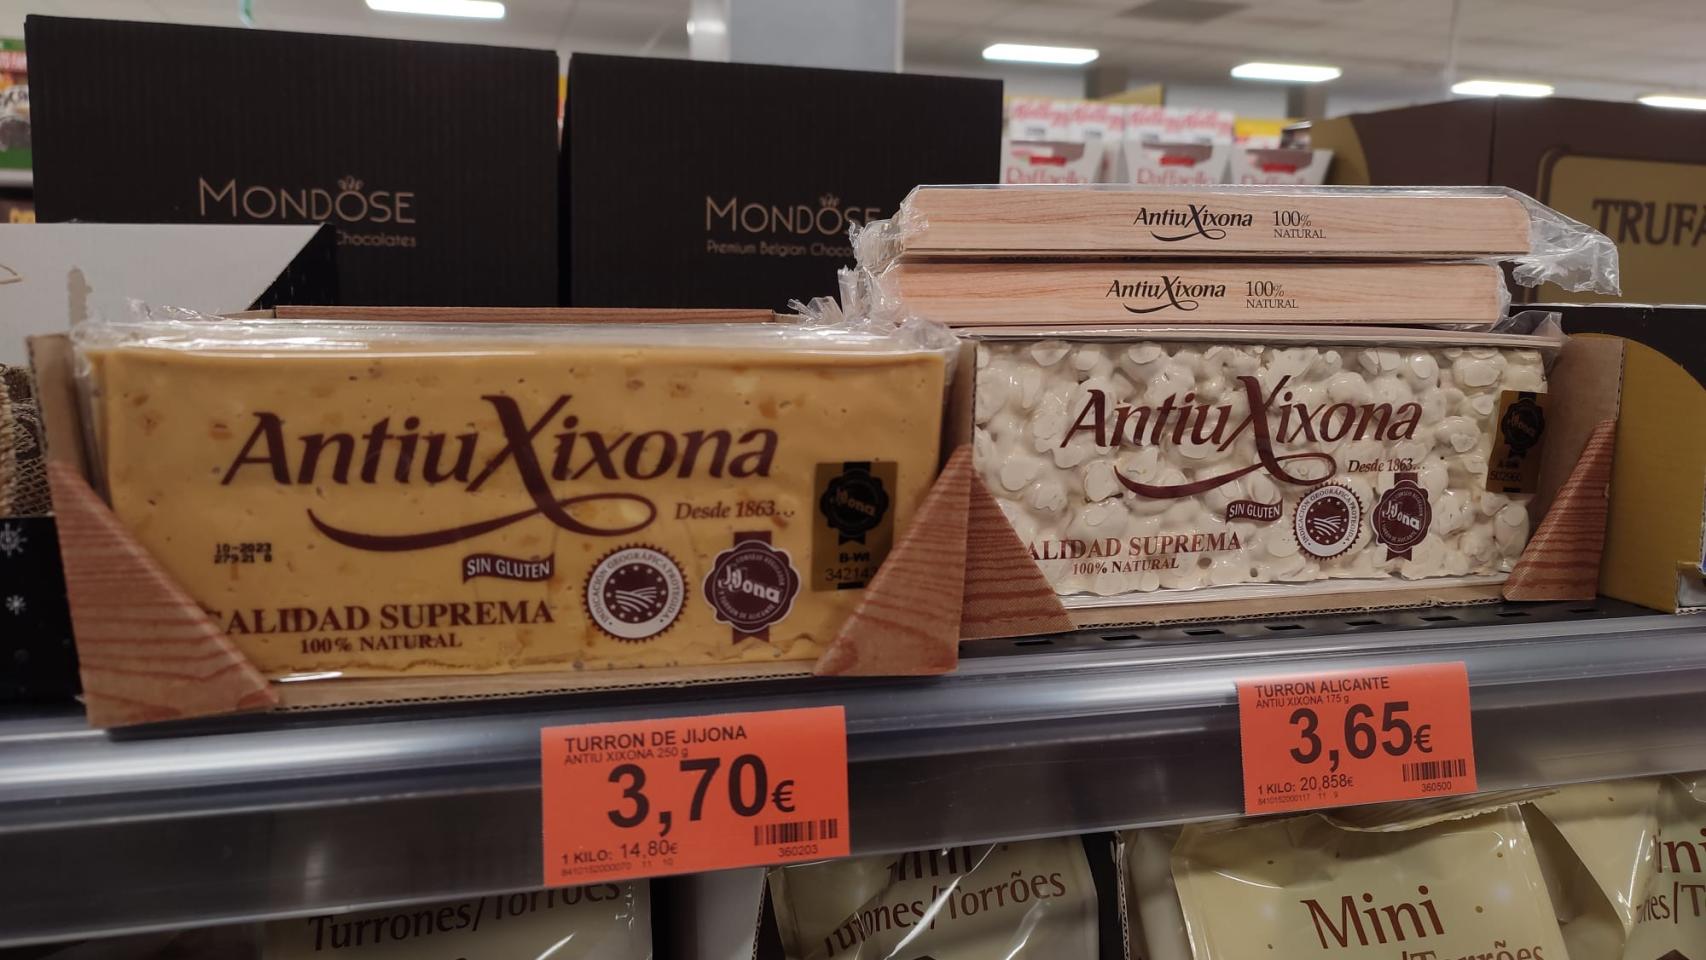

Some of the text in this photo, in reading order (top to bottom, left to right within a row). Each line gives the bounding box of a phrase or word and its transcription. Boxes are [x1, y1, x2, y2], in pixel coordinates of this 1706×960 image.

[1133, 204, 1253, 241] AntiuXixona
[1272, 210, 1312, 227] 100%
[1273, 228, 1327, 239] NATURAL
[707, 240, 757, 255] Premium
[760, 241, 807, 257] Belgian
[1107, 275, 1226, 313] AntiuXixona
[1245, 280, 1285, 297] 100%
[1246, 298, 1299, 309] NATURAL
[1061, 375, 1423, 498] AntiuXixona
[221, 394, 779, 550] AntiuXixona
[1348, 458, 1384, 473] Desde
[675, 500, 731, 520] Desde
[1229, 503, 1280, 519] SIN GLUTEN
[1128, 531, 1242, 557] SUPREMA
[466, 558, 550, 578] SIN GLUTEN
[1073, 557, 1180, 575] 100% NATURAL
[379, 600, 555, 630] SUPREMA
[300, 632, 463, 654] 100% NATURAL
[1255, 676, 1390, 698] TURRON ALICANTE
[1256, 695, 1350, 709] ANTIU XIXONA 175 g
[564, 725, 747, 753] TURRON DE JIJONA
[1288, 701, 1433, 772] 3,65€
[564, 747, 689, 765] ANTIU XIXONA 250 g
[606, 753, 796, 837] 3,70€
[1257, 784, 1263, 795] 1
[1266, 781, 1296, 794] KILO:
[1421, 780, 1452, 793] 360500
[561, 853, 569, 865] 1
[573, 849, 614, 864] KILO:
[776, 844, 819, 858] 360203
[1300, 885, 1445, 950] Mini
